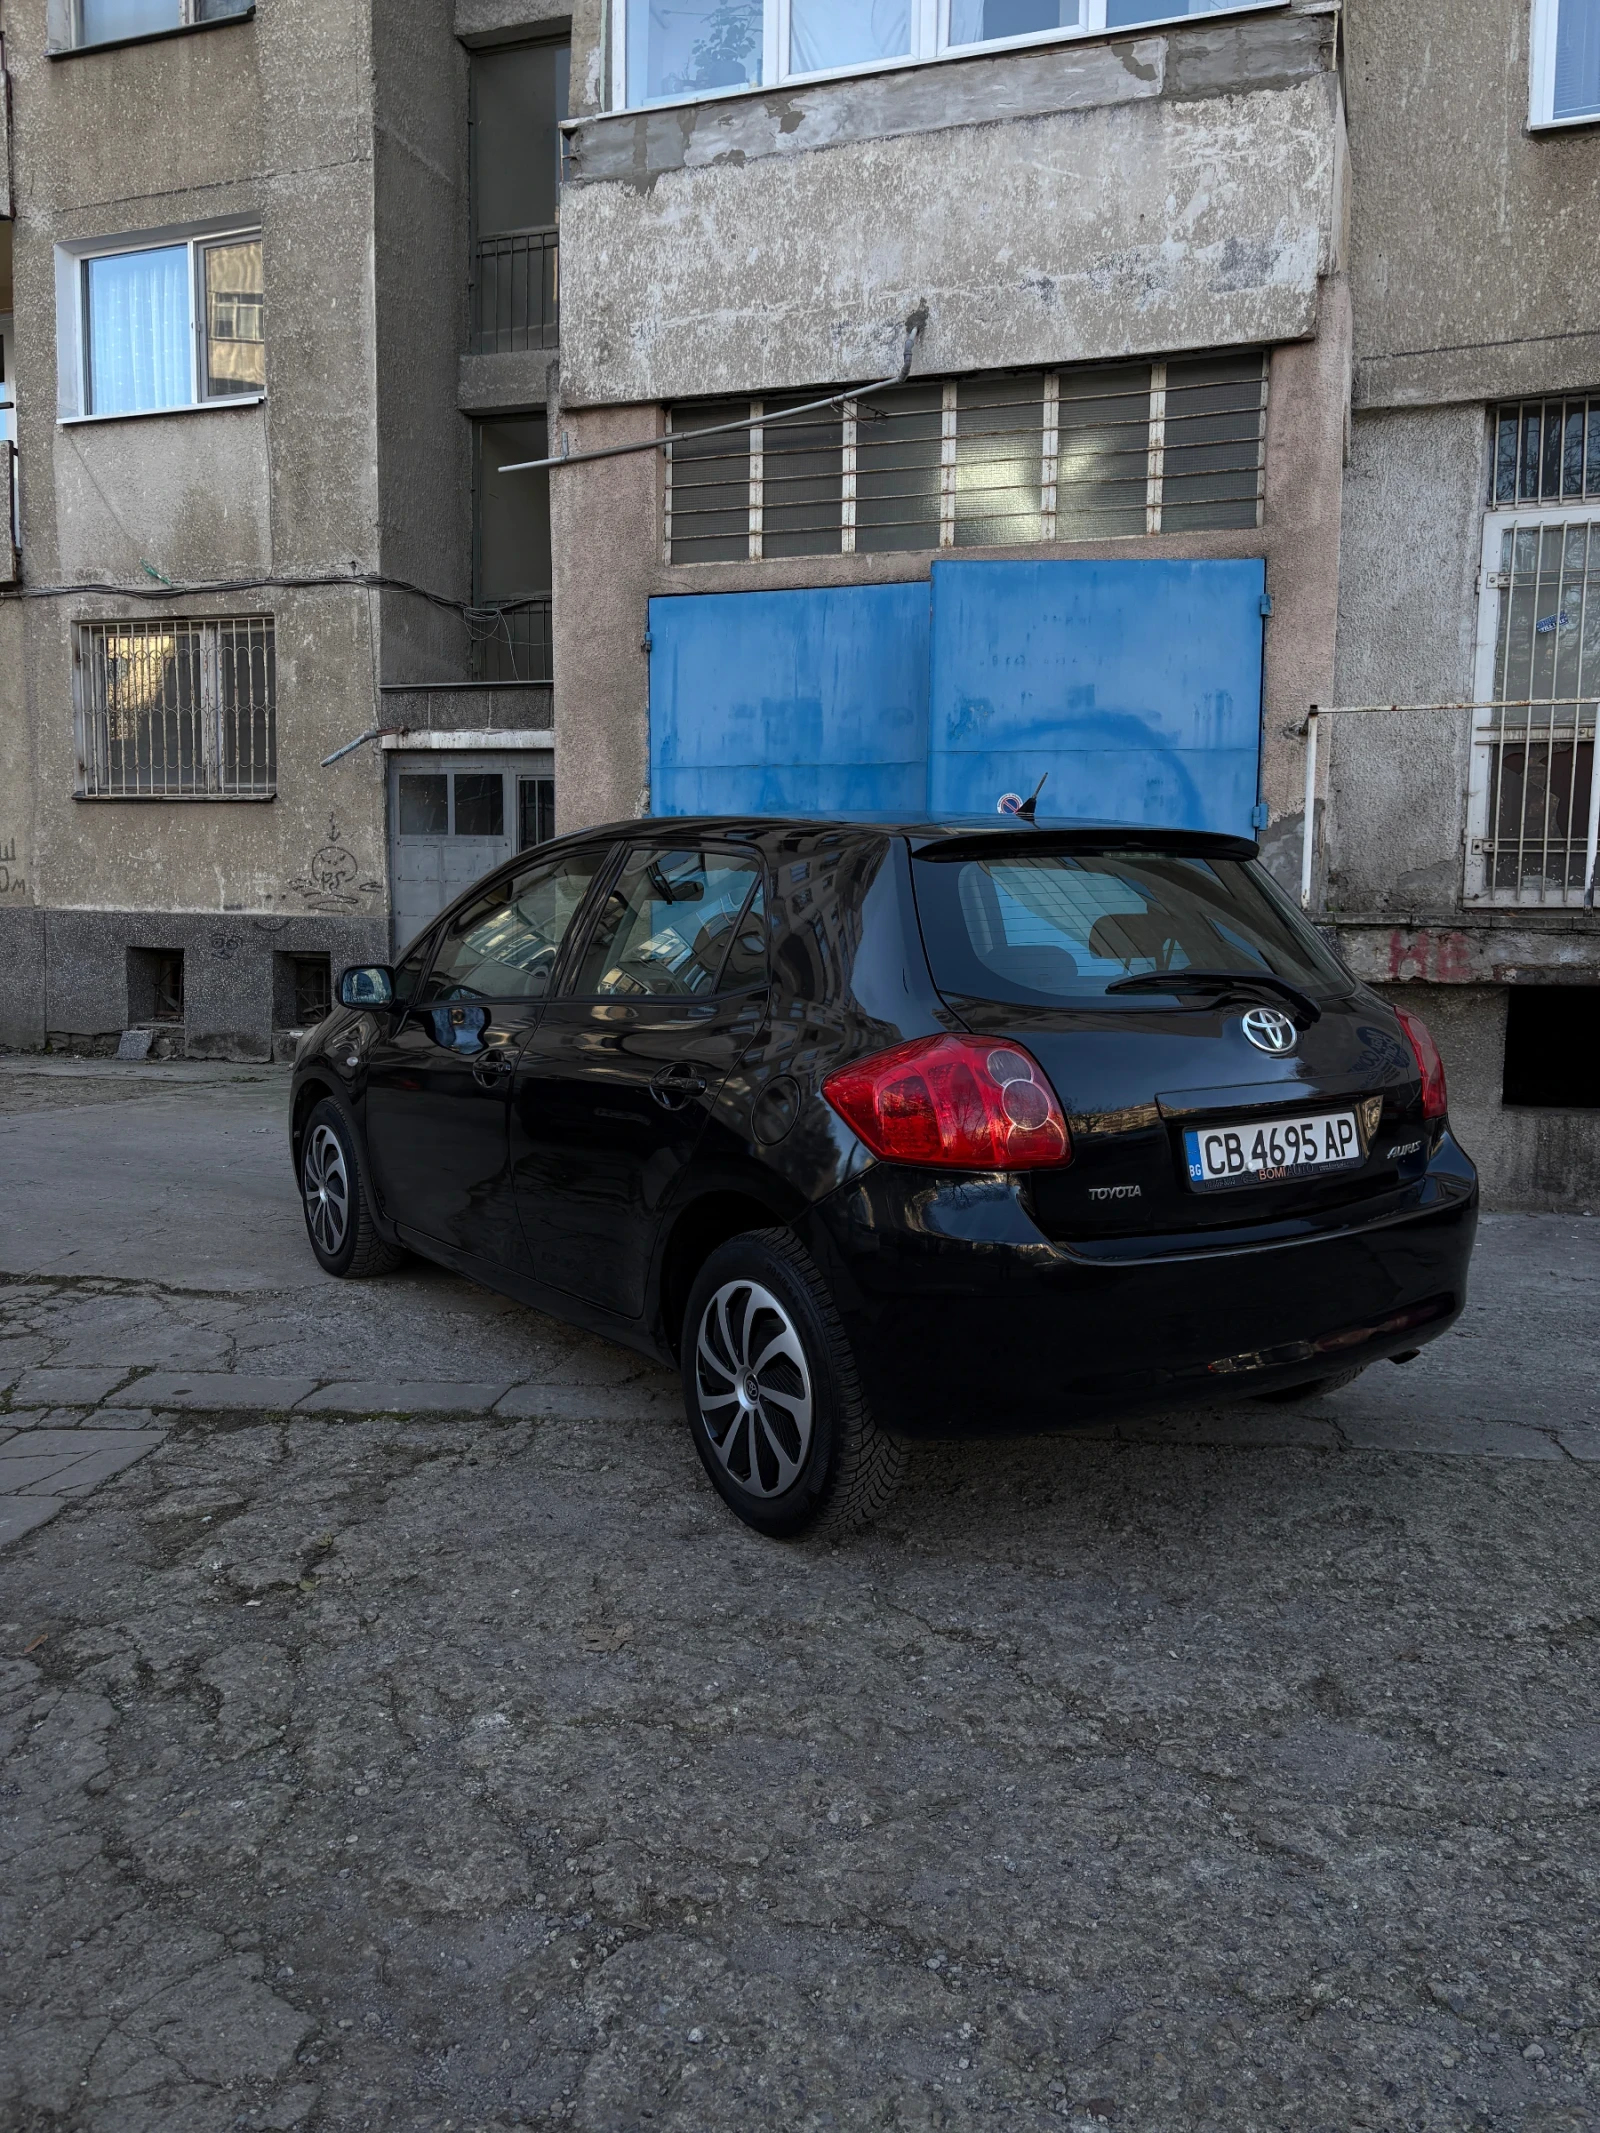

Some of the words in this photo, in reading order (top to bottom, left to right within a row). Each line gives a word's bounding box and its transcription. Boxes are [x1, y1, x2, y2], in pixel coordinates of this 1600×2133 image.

[1205, 1132, 1244, 1175] CB
[1251, 1122, 1318, 1169] 4695
[1325, 1119, 1353, 1159] AP
[1386, 1140, 1421, 1159] AURIS
[1189, 1163, 1202, 1177] BG
[1088, 1185, 1142, 1200] TOYOTA
